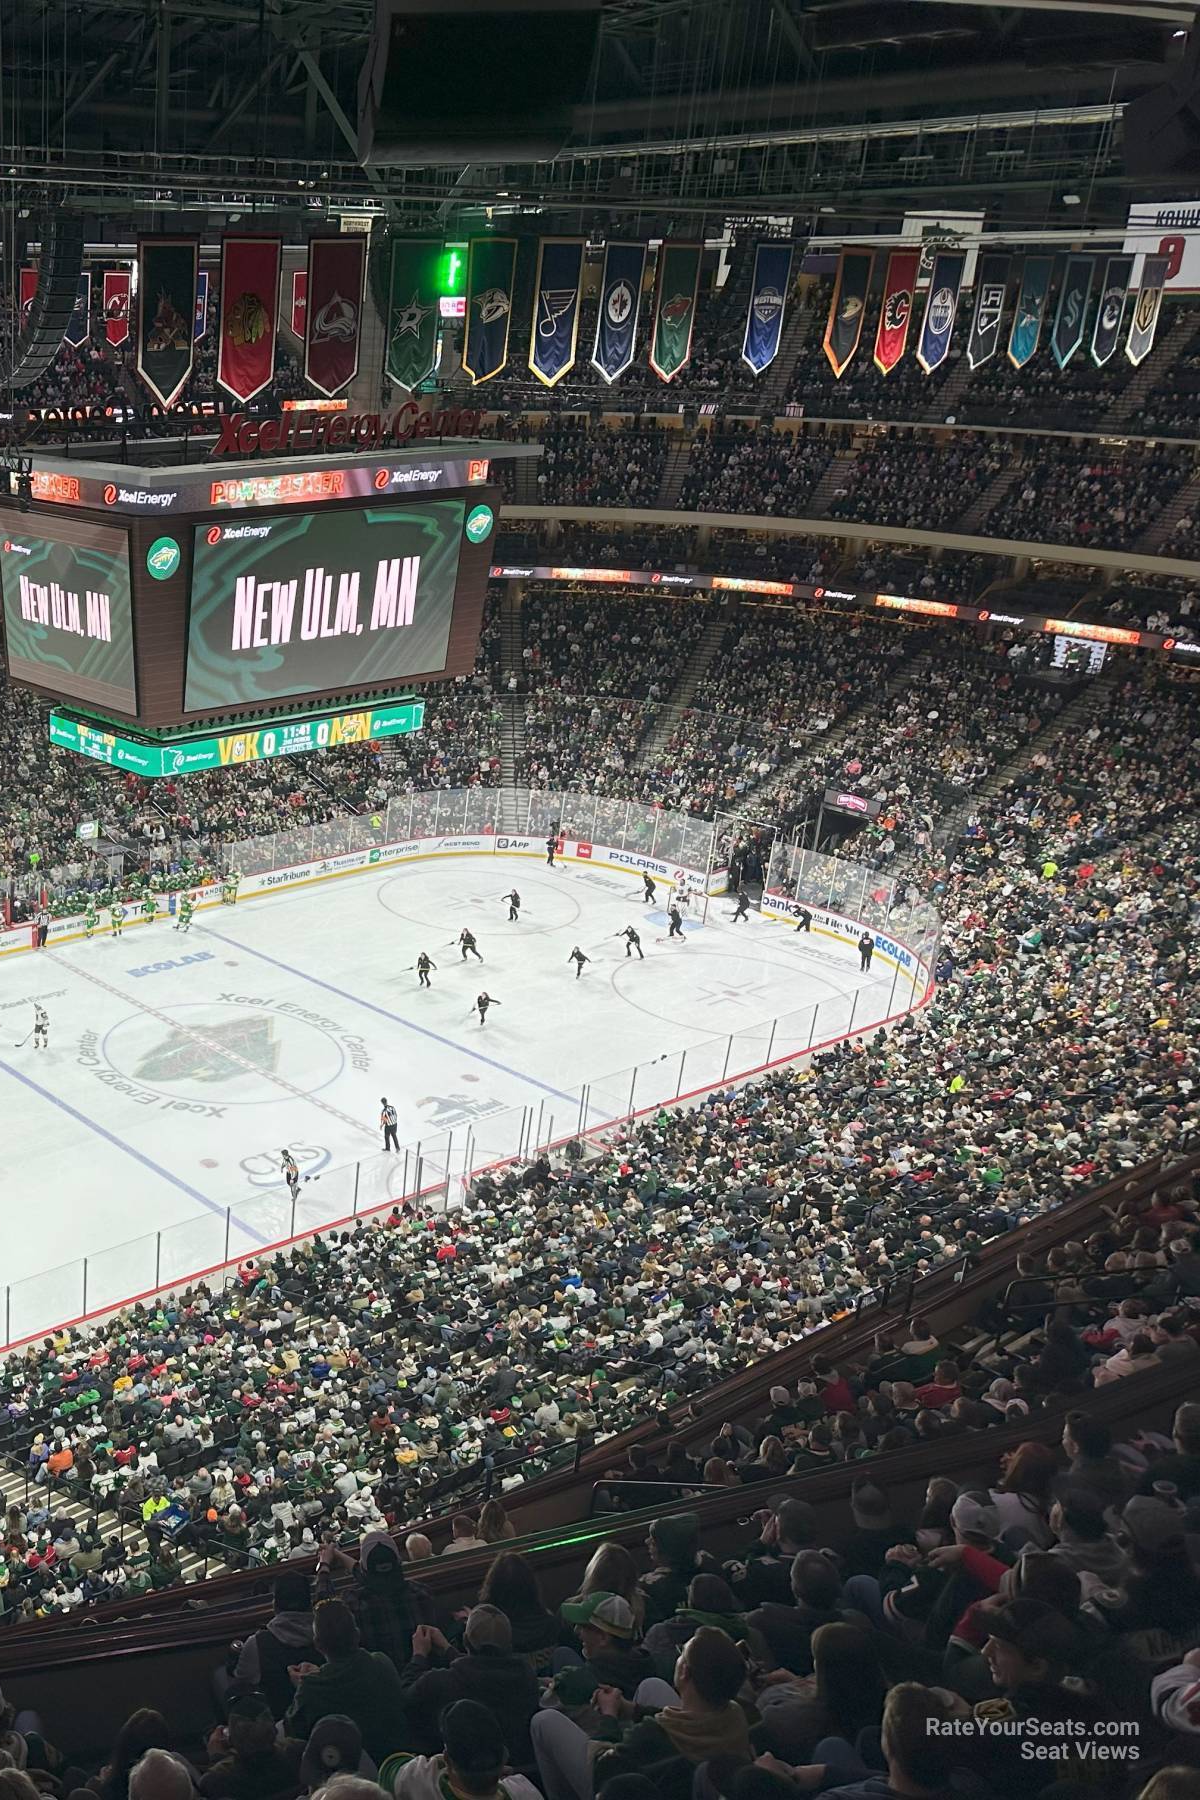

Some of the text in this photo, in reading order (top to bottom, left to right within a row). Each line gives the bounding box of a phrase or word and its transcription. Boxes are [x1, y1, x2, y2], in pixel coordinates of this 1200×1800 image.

[1159, 233, 1186, 280] 9
[211, 400, 487, 456] Xcel Energy Center
[85, 590, 112, 643] MN
[369, 555, 421, 631] MN
[263, 732, 276, 754] 0
[316, 723, 329, 745] 0
[608, 851, 668, 875] POLARIS
[875, 935, 912, 967] ECOLAB
[216, 992, 377, 1073] Xcel Energy Center
[76, 1028, 229, 1119] Xcel Energy Center
